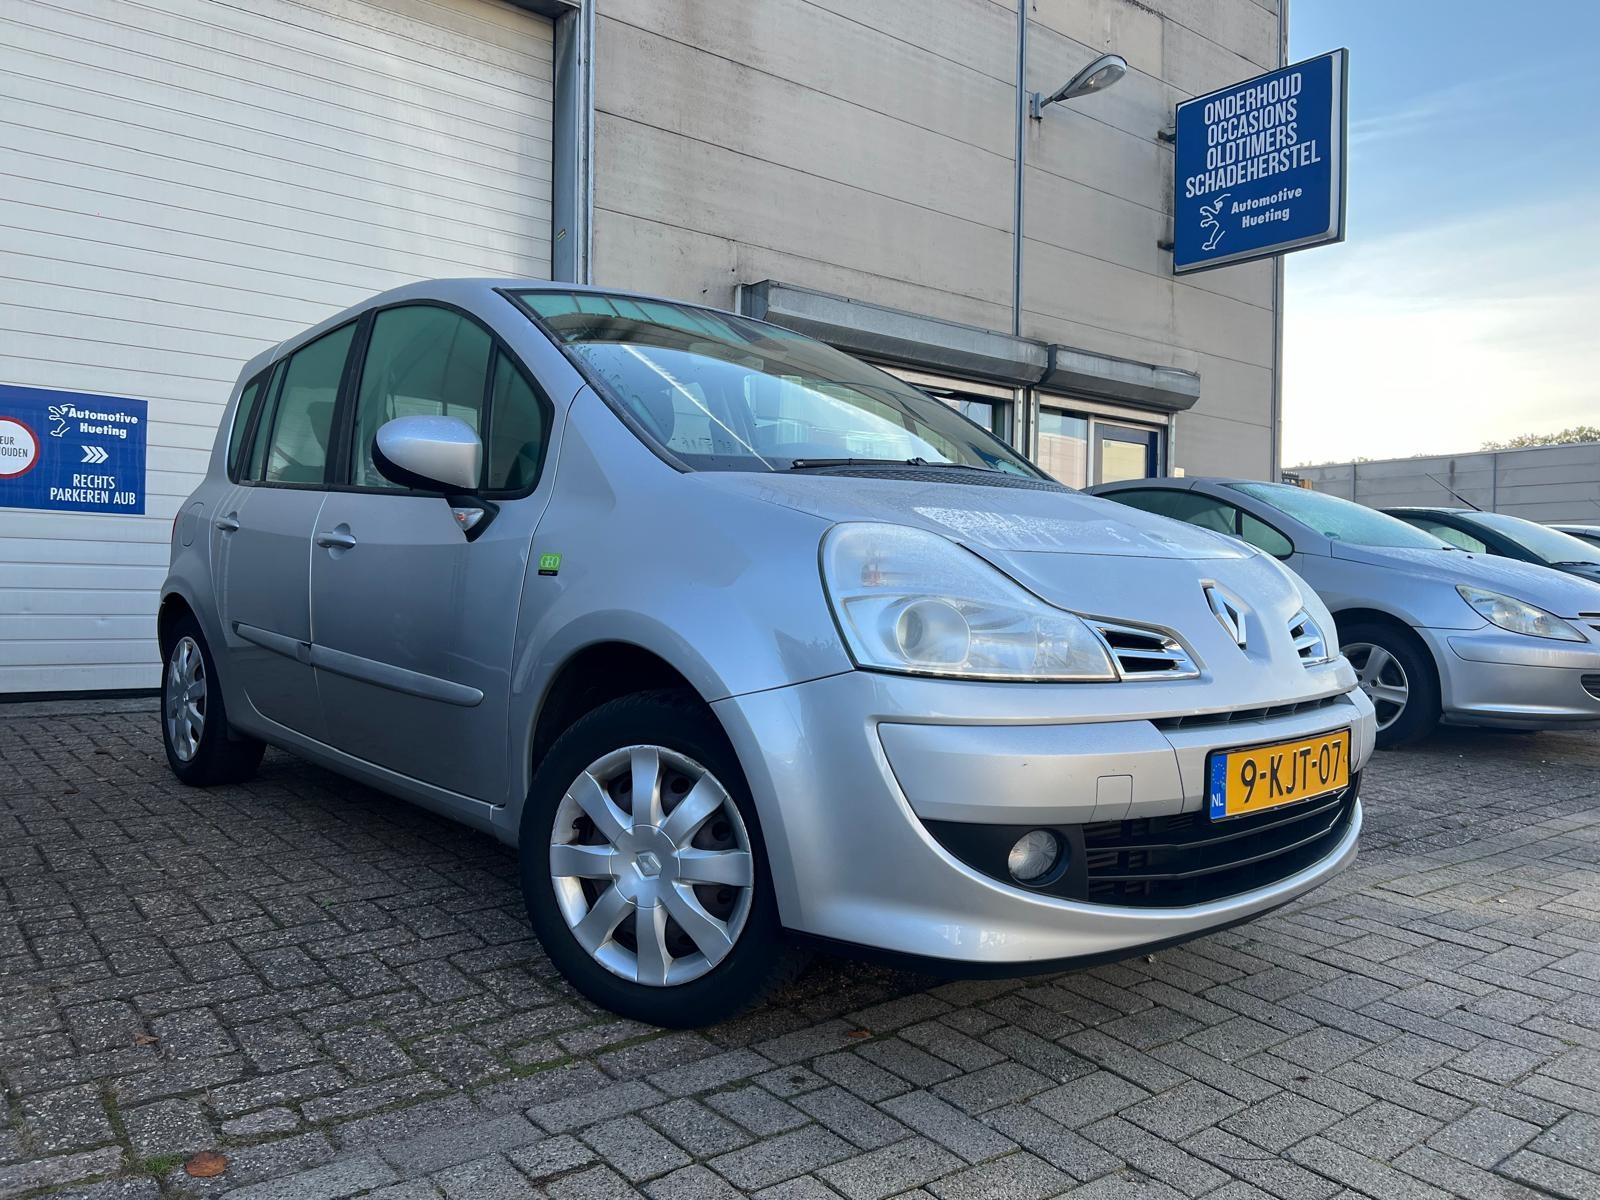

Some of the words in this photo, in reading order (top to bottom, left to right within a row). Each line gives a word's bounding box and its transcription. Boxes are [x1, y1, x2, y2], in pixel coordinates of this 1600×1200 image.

[1204, 72, 1302, 125] ONDERHOUD
[1207, 98, 1297, 147] OCCASIONS
[1206, 122, 1297, 170] OLDTIMERS
[1185, 140, 1321, 198] SCHADEHERSTEL
[1231, 187, 1303, 215] Automotive
[1241, 207, 1290, 228] Hueting
[68, 407, 139, 424] Automotive
[79, 422, 128, 439] Hueting
[0, 446, 28, 458] OUDEN
[73, 473, 115, 489] RECHTS
[50, 487, 109, 504] PARKEREN
[113, 491, 136, 505] AUB
[1240, 741, 1341, 804] 9-KJT-07
[1212, 793, 1224, 808] NL
